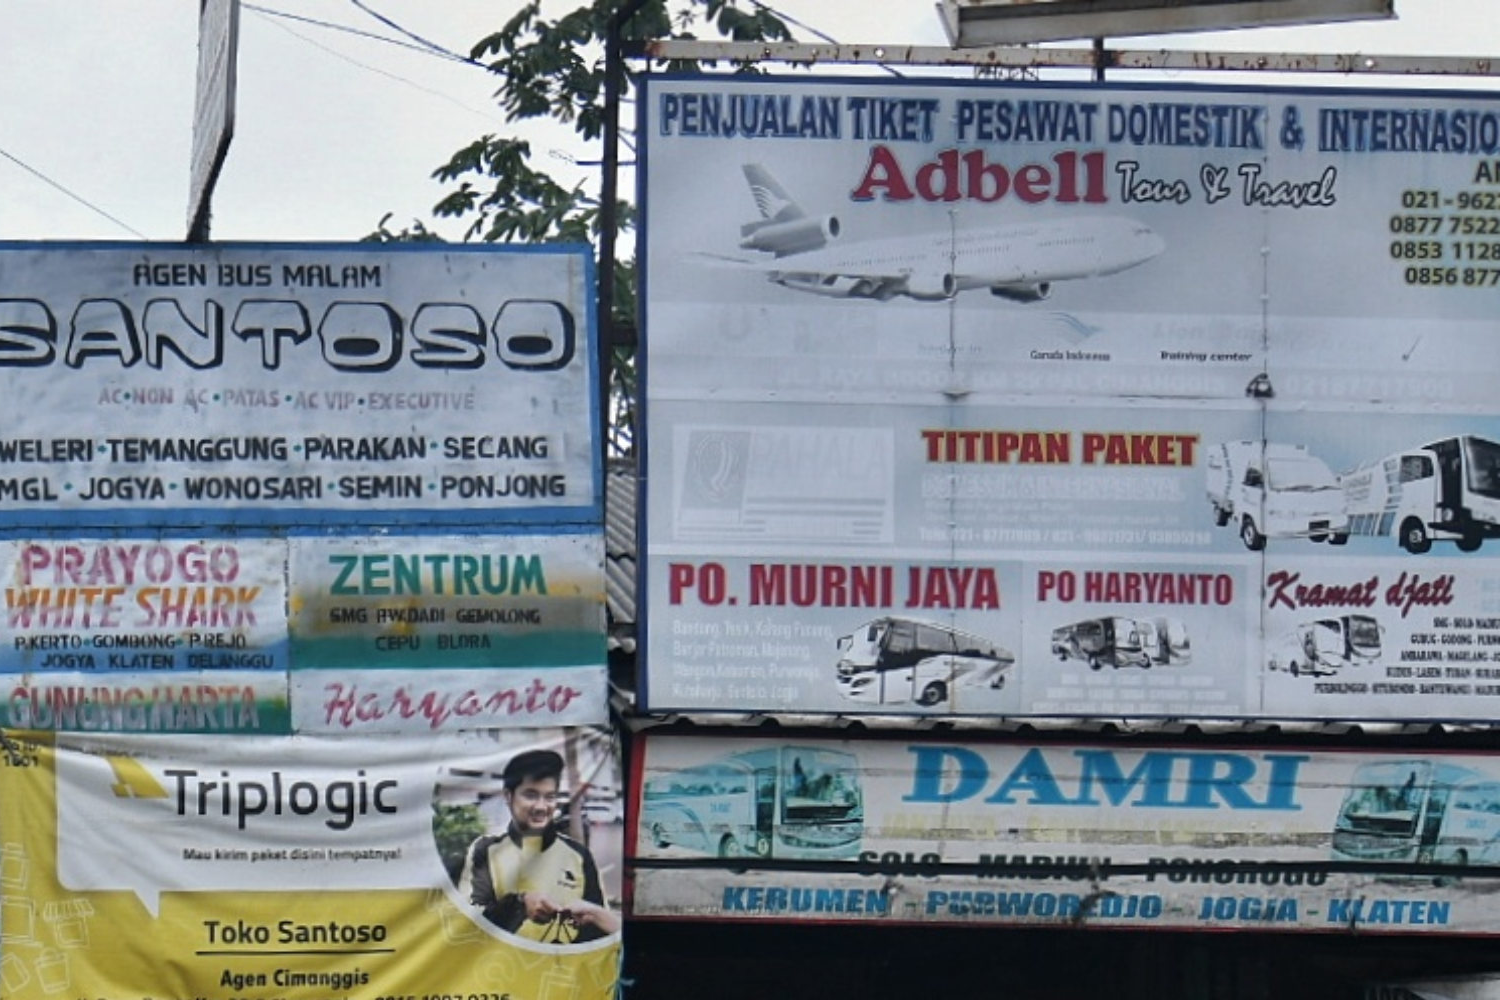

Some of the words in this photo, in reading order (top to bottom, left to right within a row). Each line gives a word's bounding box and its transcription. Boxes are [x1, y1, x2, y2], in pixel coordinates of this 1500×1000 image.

[659, 92, 842, 139] PENJUALAN
[847, 96, 939, 142] TIKET
[956, 99, 1098, 143] PESAWAT
[1108, 103, 1265, 150] DOMESTIK
[1281, 106, 1304, 151] &
[852, 144, 1109, 204] Adbell
[1115, 161, 1192, 204] Tour
[1238, 164, 1337, 207] Travel
[1390, 215, 1443, 234] 0877
[1390, 241, 1442, 260] 0853
[133, 264, 208, 288] AGEN
[217, 264, 273, 287] BUS
[283, 264, 382, 288] MALAM
[1404, 267, 1457, 285] 0856
[106, 438, 288, 463] TEMANGGUNG
[304, 438, 426, 461] PARAKAN
[444, 437, 548, 460] SECANG
[921, 429, 1071, 464] TITIPAN
[1082, 432, 1199, 467] PAKET
[78, 477, 166, 501] JOGYA
[184, 476, 322, 500] WONOSARI
[338, 476, 423, 499] SEMIN
[440, 475, 566, 500] PONJONG
[21, 544, 240, 586] PRAYOGO
[328, 554, 547, 596] ZENTRUM
[668, 561, 737, 607] PO.
[749, 563, 893, 609] MURNI
[905, 565, 1001, 611] JAYA
[1037, 570, 1076, 603] PO
[1085, 572, 1234, 606] HARYANTO
[1267, 569, 1380, 611] Kramat
[1385, 571, 1456, 618] djati
[5, 586, 126, 630] WHITE
[136, 584, 259, 629] SHARK
[41, 654, 95, 669] JOGYA
[109, 654, 174, 669] KLATEN
[188, 654, 274, 669] DELANGGU
[152, 685, 260, 729] HARTA
[323, 677, 582, 730] Haryanto
[905, 745, 1309, 812] DAMRI
[164, 768, 398, 831] Triplogic
[183, 848, 211, 860] Mau
[215, 848, 247, 860] kirim
[251, 848, 286, 862] paket
[289, 847, 325, 860] disini
[1198, 895, 1298, 922] JOGJA
[1328, 897, 1450, 925] KLATEN
[204, 921, 270, 944] Toko
[278, 920, 387, 944] Santoso
[220, 970, 266, 989] Agen
[274, 969, 369, 990] Cimanggis
